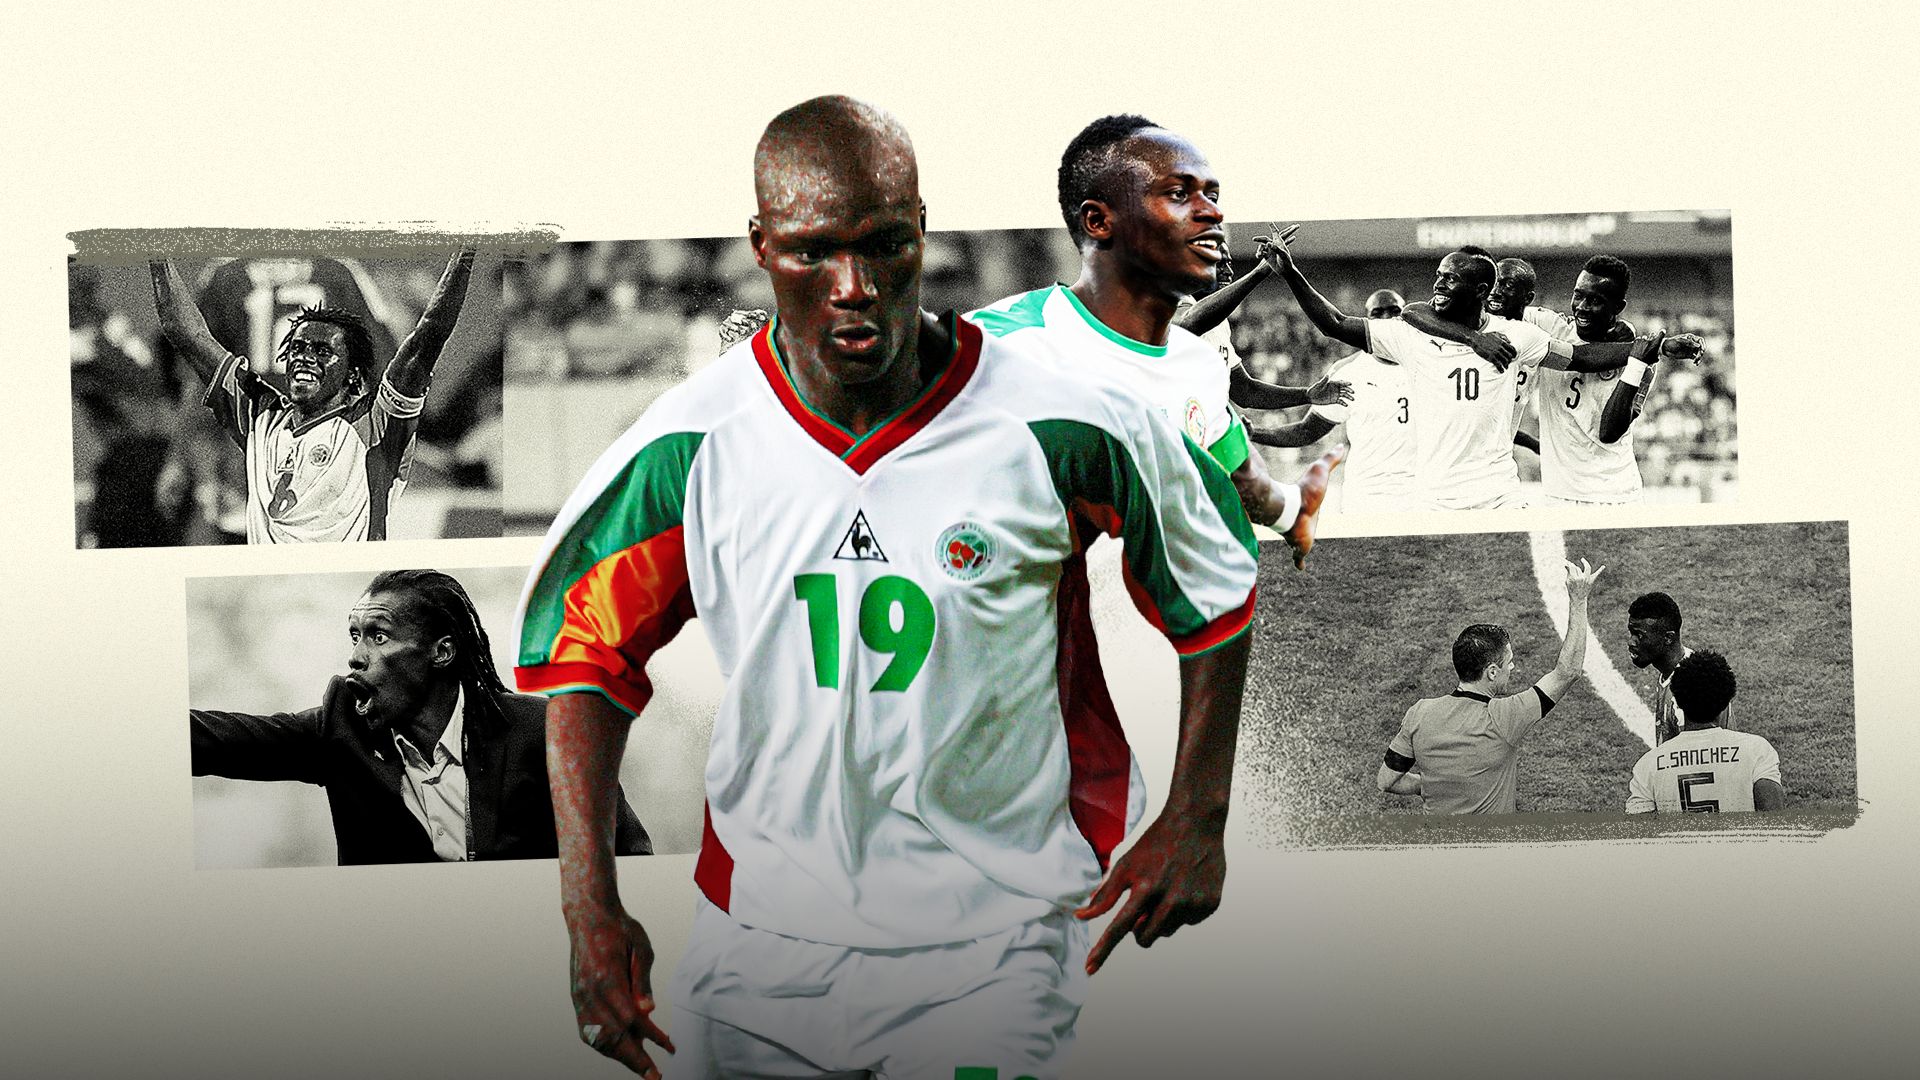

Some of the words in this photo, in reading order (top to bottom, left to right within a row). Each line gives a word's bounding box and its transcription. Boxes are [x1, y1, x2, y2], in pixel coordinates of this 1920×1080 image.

[1448, 368, 1479, 400] 10
[1566, 377, 1584, 409] 5
[1397, 397, 1409, 424] 3
[268, 473, 298, 519] 6
[794, 573, 936, 693] 19
[1657, 746, 1740, 770] C.SANCHEZ
[1677, 772, 1719, 812] 5
